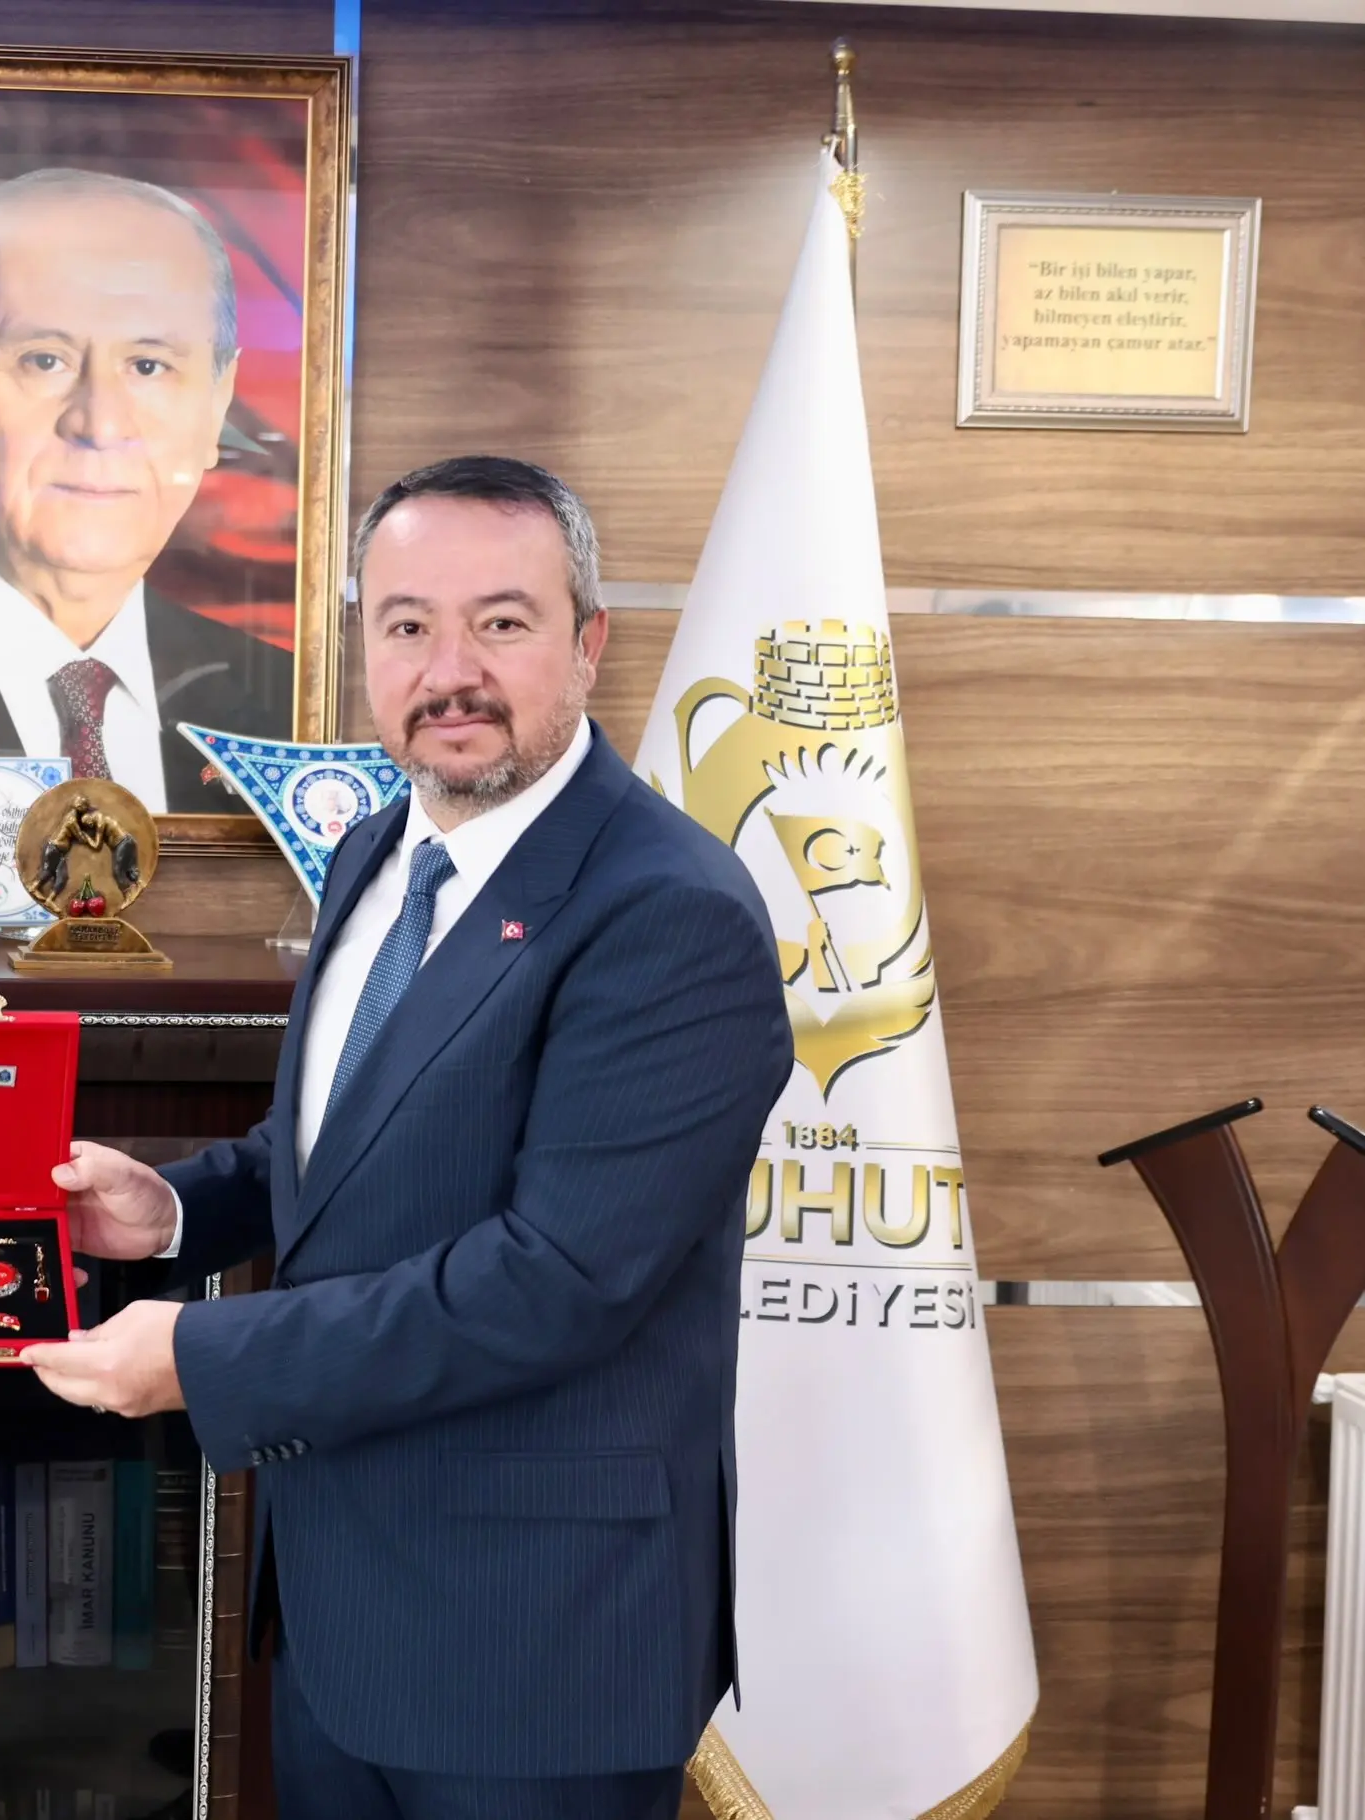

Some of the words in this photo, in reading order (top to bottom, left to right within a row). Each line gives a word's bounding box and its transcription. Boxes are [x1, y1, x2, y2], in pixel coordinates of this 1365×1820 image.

[1071, 261, 1091, 281] işi
[1096, 262, 1138, 279] bilen
[1034, 288, 1053, 300] az
[1059, 286, 1100, 301] bilen
[1106, 287, 1138, 302] akıl
[1034, 308, 1112, 328] bilmeyen
[1001, 333, 1101, 351] yapamayan
[1108, 336, 1163, 353] çamur
[81, 1512, 96, 1582] KANUNU
[78, 1589, 96, 1630] İMAR
